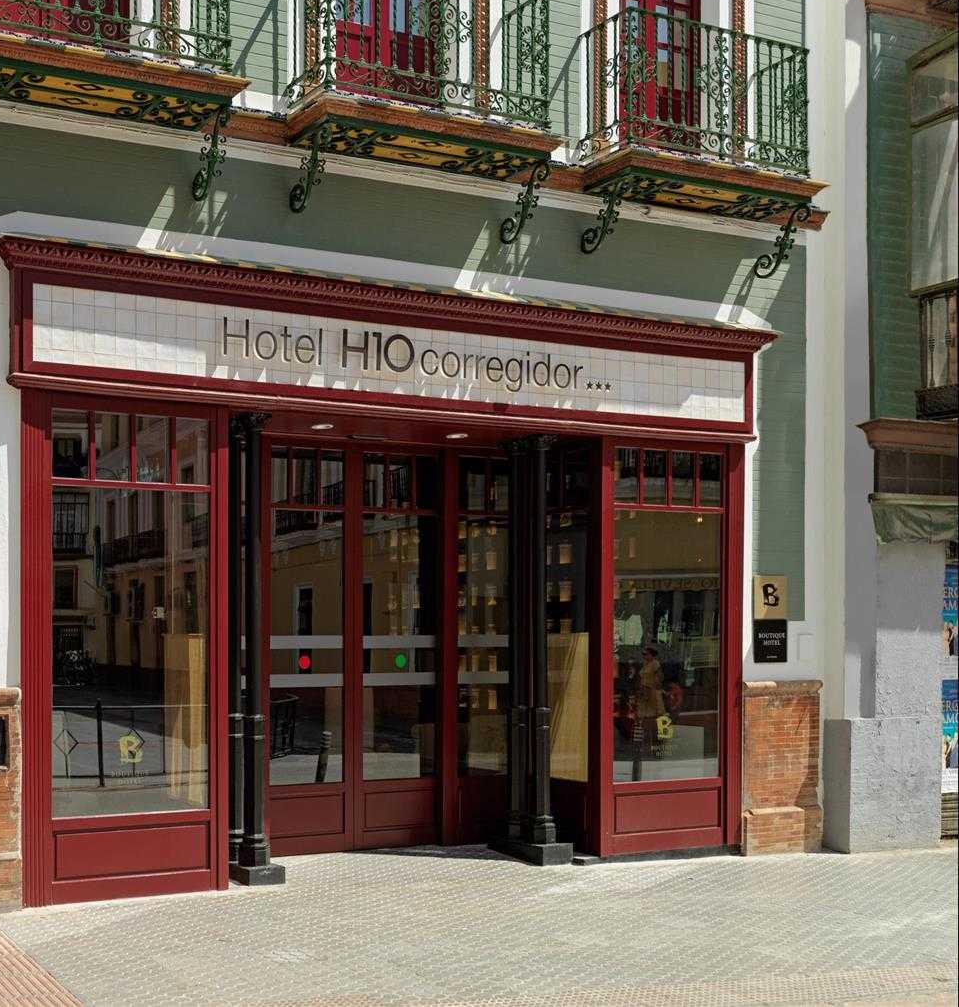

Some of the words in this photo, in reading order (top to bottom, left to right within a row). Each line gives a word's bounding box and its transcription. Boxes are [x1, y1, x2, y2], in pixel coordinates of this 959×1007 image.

[221, 316, 324, 366] Hotel
[340, 327, 416, 373] H10
[419, 349, 584, 393] corregidor
